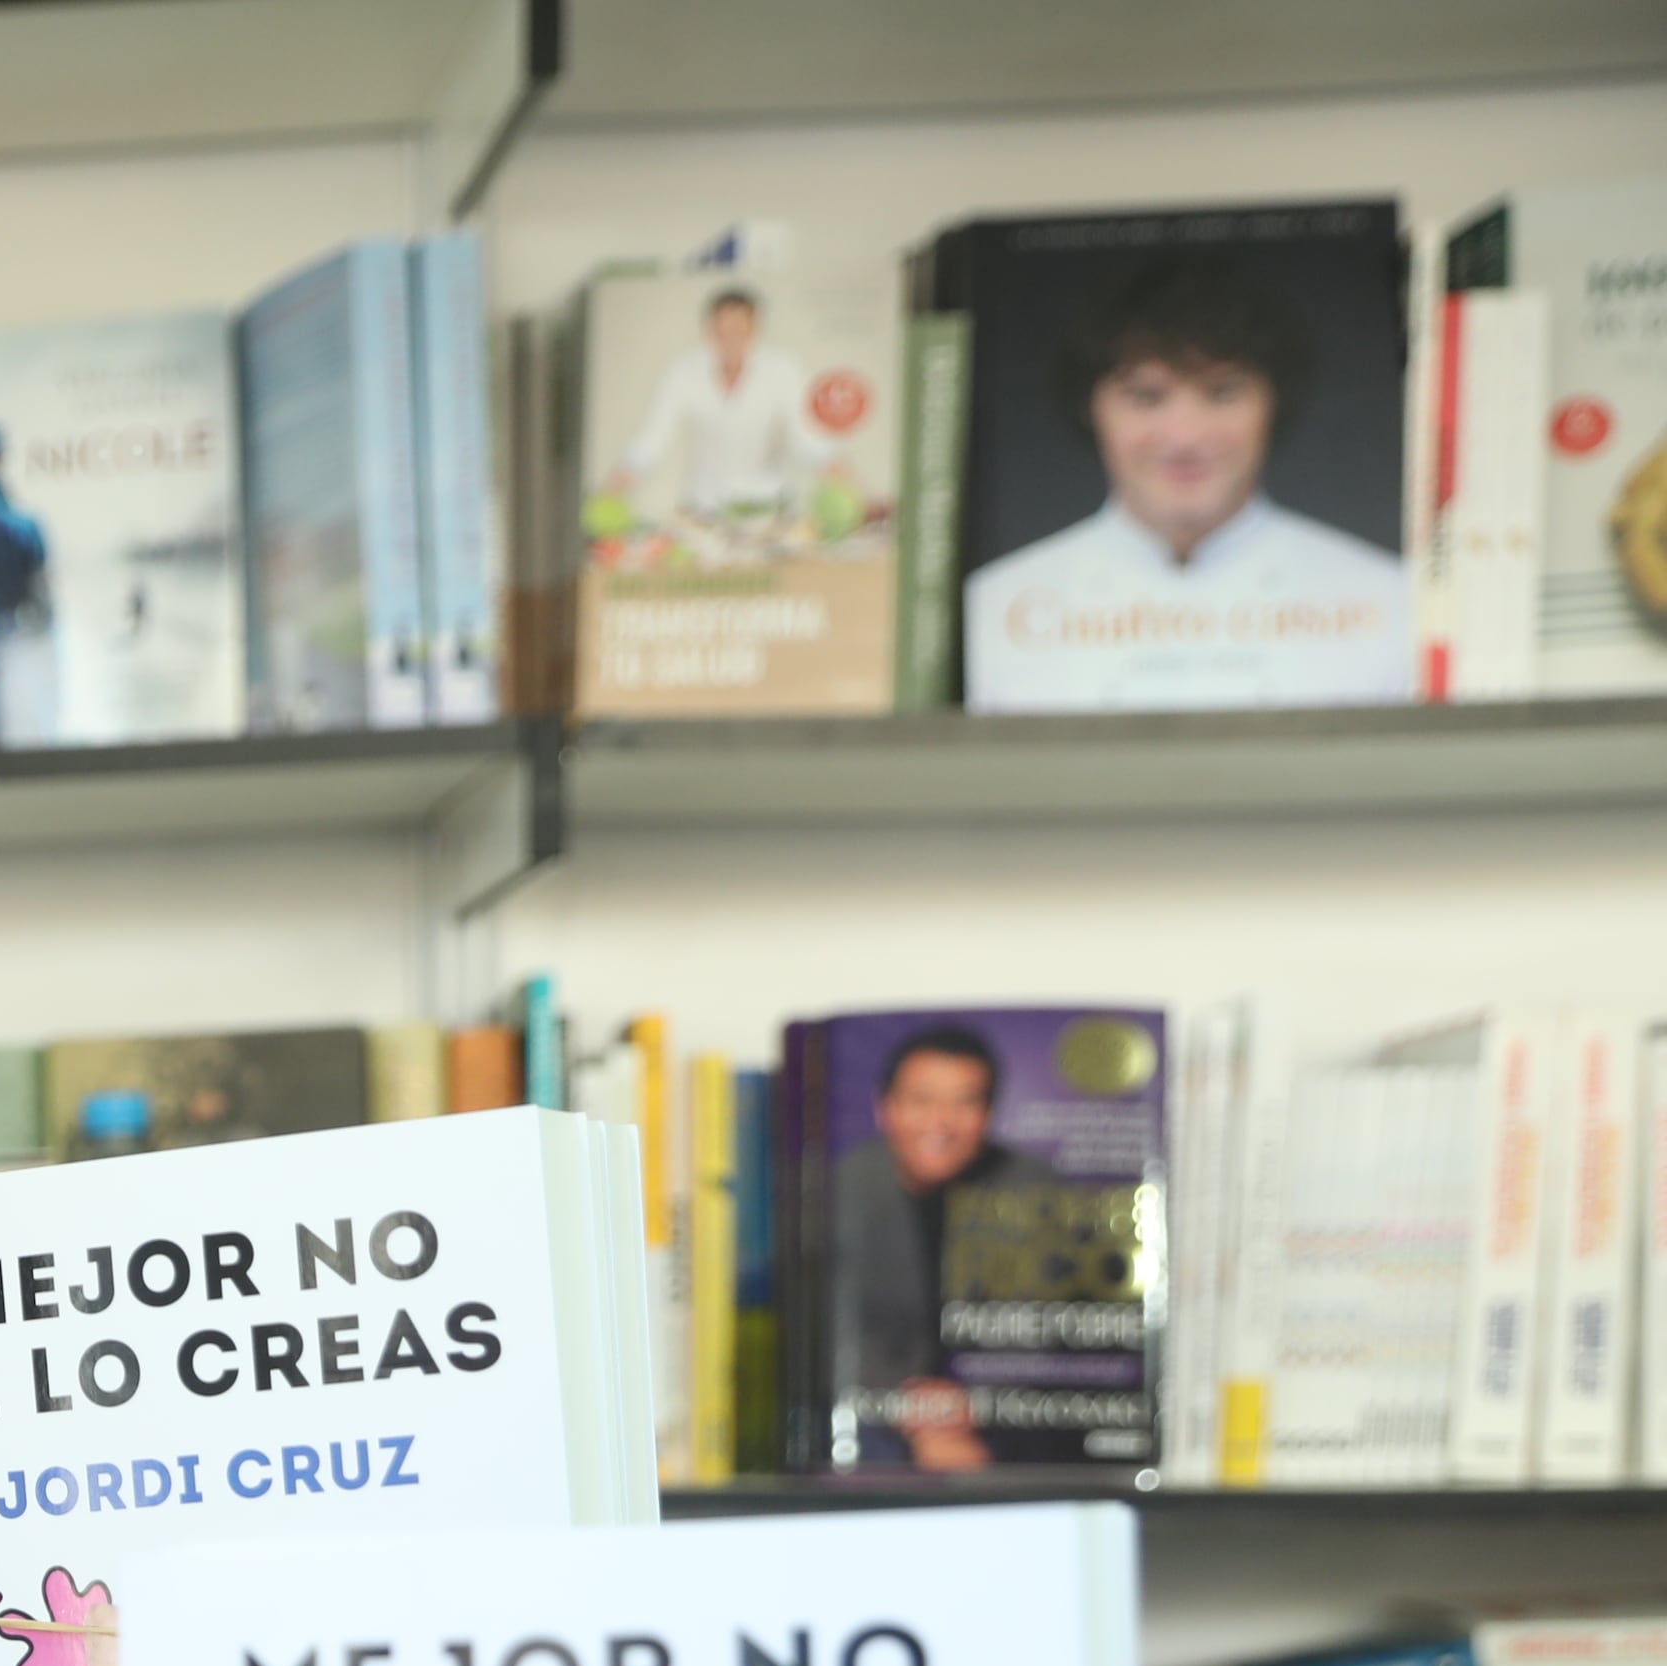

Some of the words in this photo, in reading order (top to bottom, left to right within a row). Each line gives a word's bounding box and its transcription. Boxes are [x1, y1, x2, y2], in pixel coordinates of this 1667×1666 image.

[295, 1210, 439, 1291] NO
[31, 1339, 141, 1414] LO
[176, 1301, 502, 1397] CREAS
[226, 1434, 419, 1499] CRUZ
